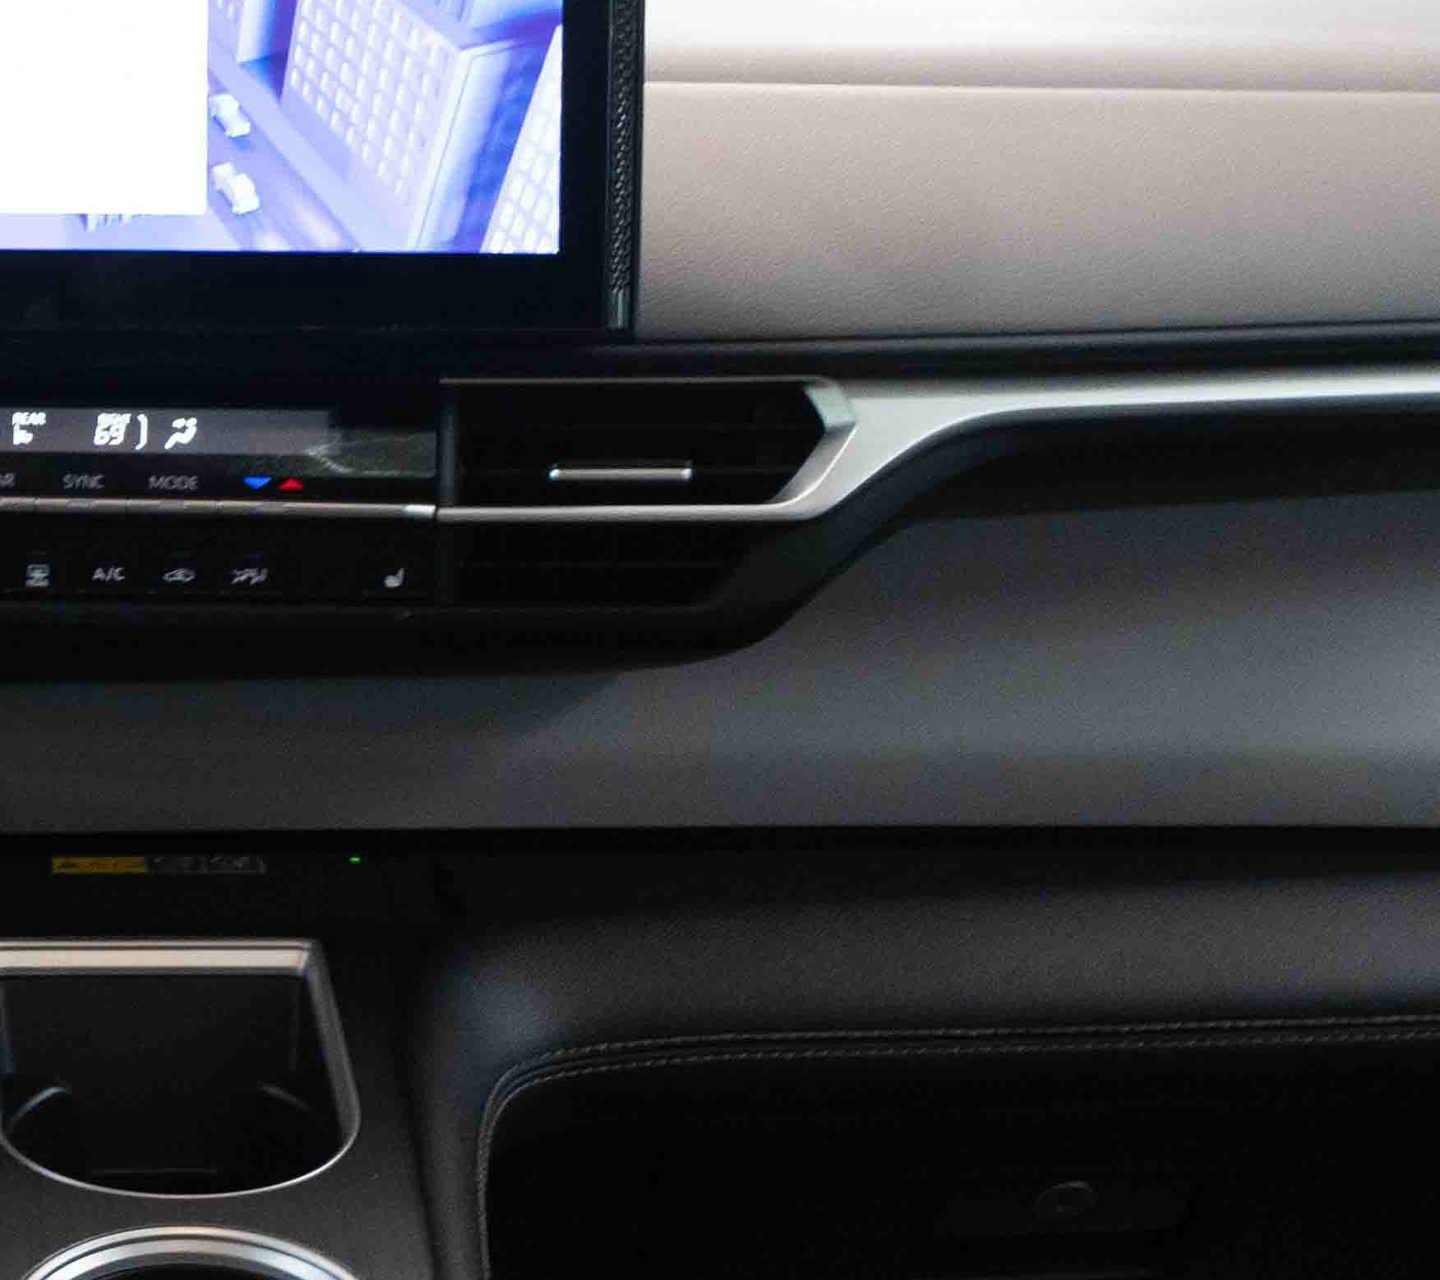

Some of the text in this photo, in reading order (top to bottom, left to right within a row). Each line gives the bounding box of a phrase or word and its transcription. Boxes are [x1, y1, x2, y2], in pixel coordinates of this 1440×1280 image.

[62, 473, 106, 490] SYNC
[149, 475, 200, 491] MODE
[92, 567, 126, 583] A/C
